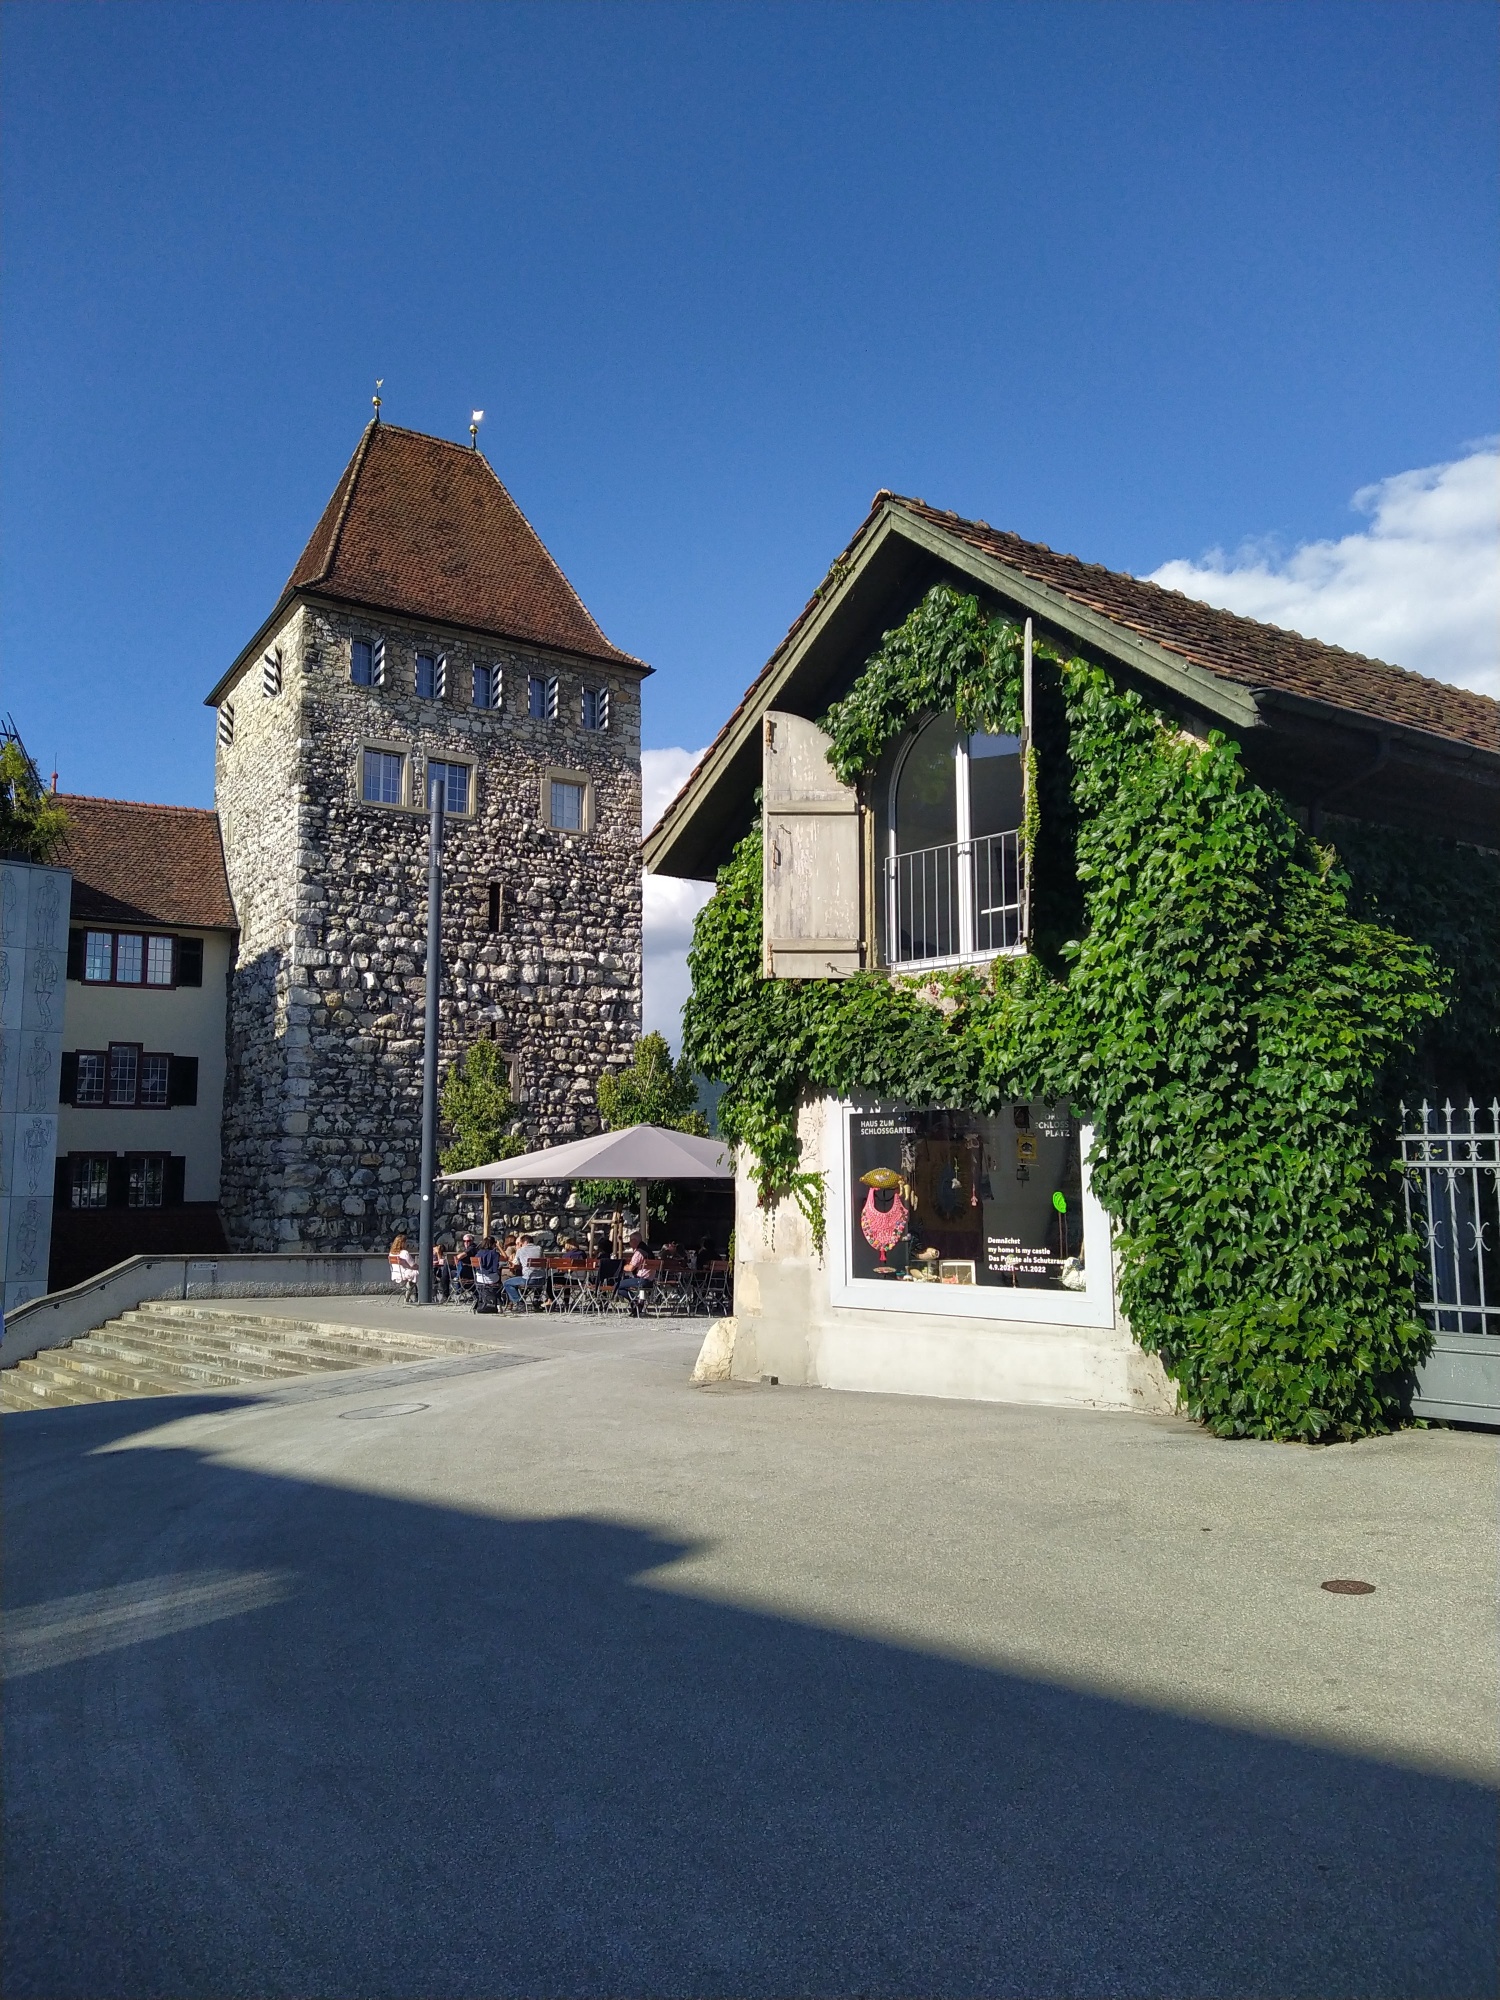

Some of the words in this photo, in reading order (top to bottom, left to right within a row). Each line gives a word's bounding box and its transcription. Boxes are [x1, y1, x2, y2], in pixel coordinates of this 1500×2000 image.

[1035, 1121, 1069, 1129] SCHLOSS
[861, 1127, 916, 1135] SCHLOSSGARTEN
[998, 1246, 1014, 1254] home
[1015, 1246, 1021, 1254] is
